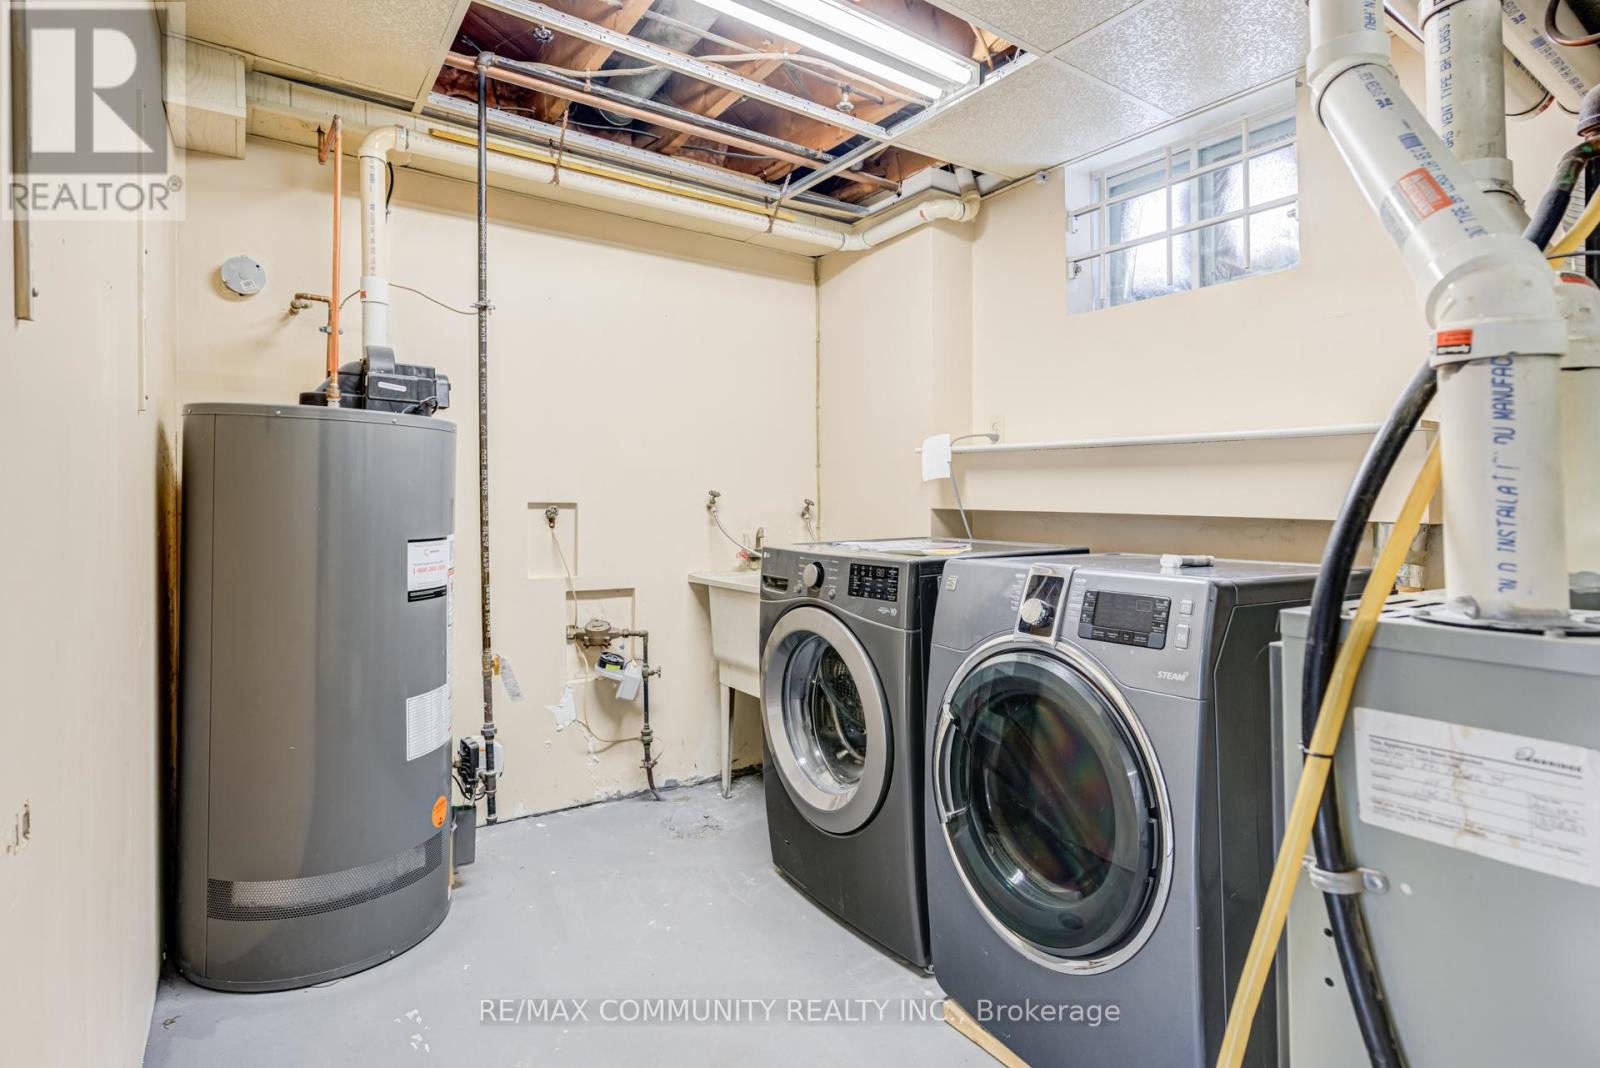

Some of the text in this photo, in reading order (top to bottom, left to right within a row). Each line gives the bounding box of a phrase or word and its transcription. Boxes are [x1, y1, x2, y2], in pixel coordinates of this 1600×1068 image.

[1438, 24, 1451, 55] CLASS
[1440, 74, 1453, 100] TYPE
[1440, 103, 1454, 128] VENT
